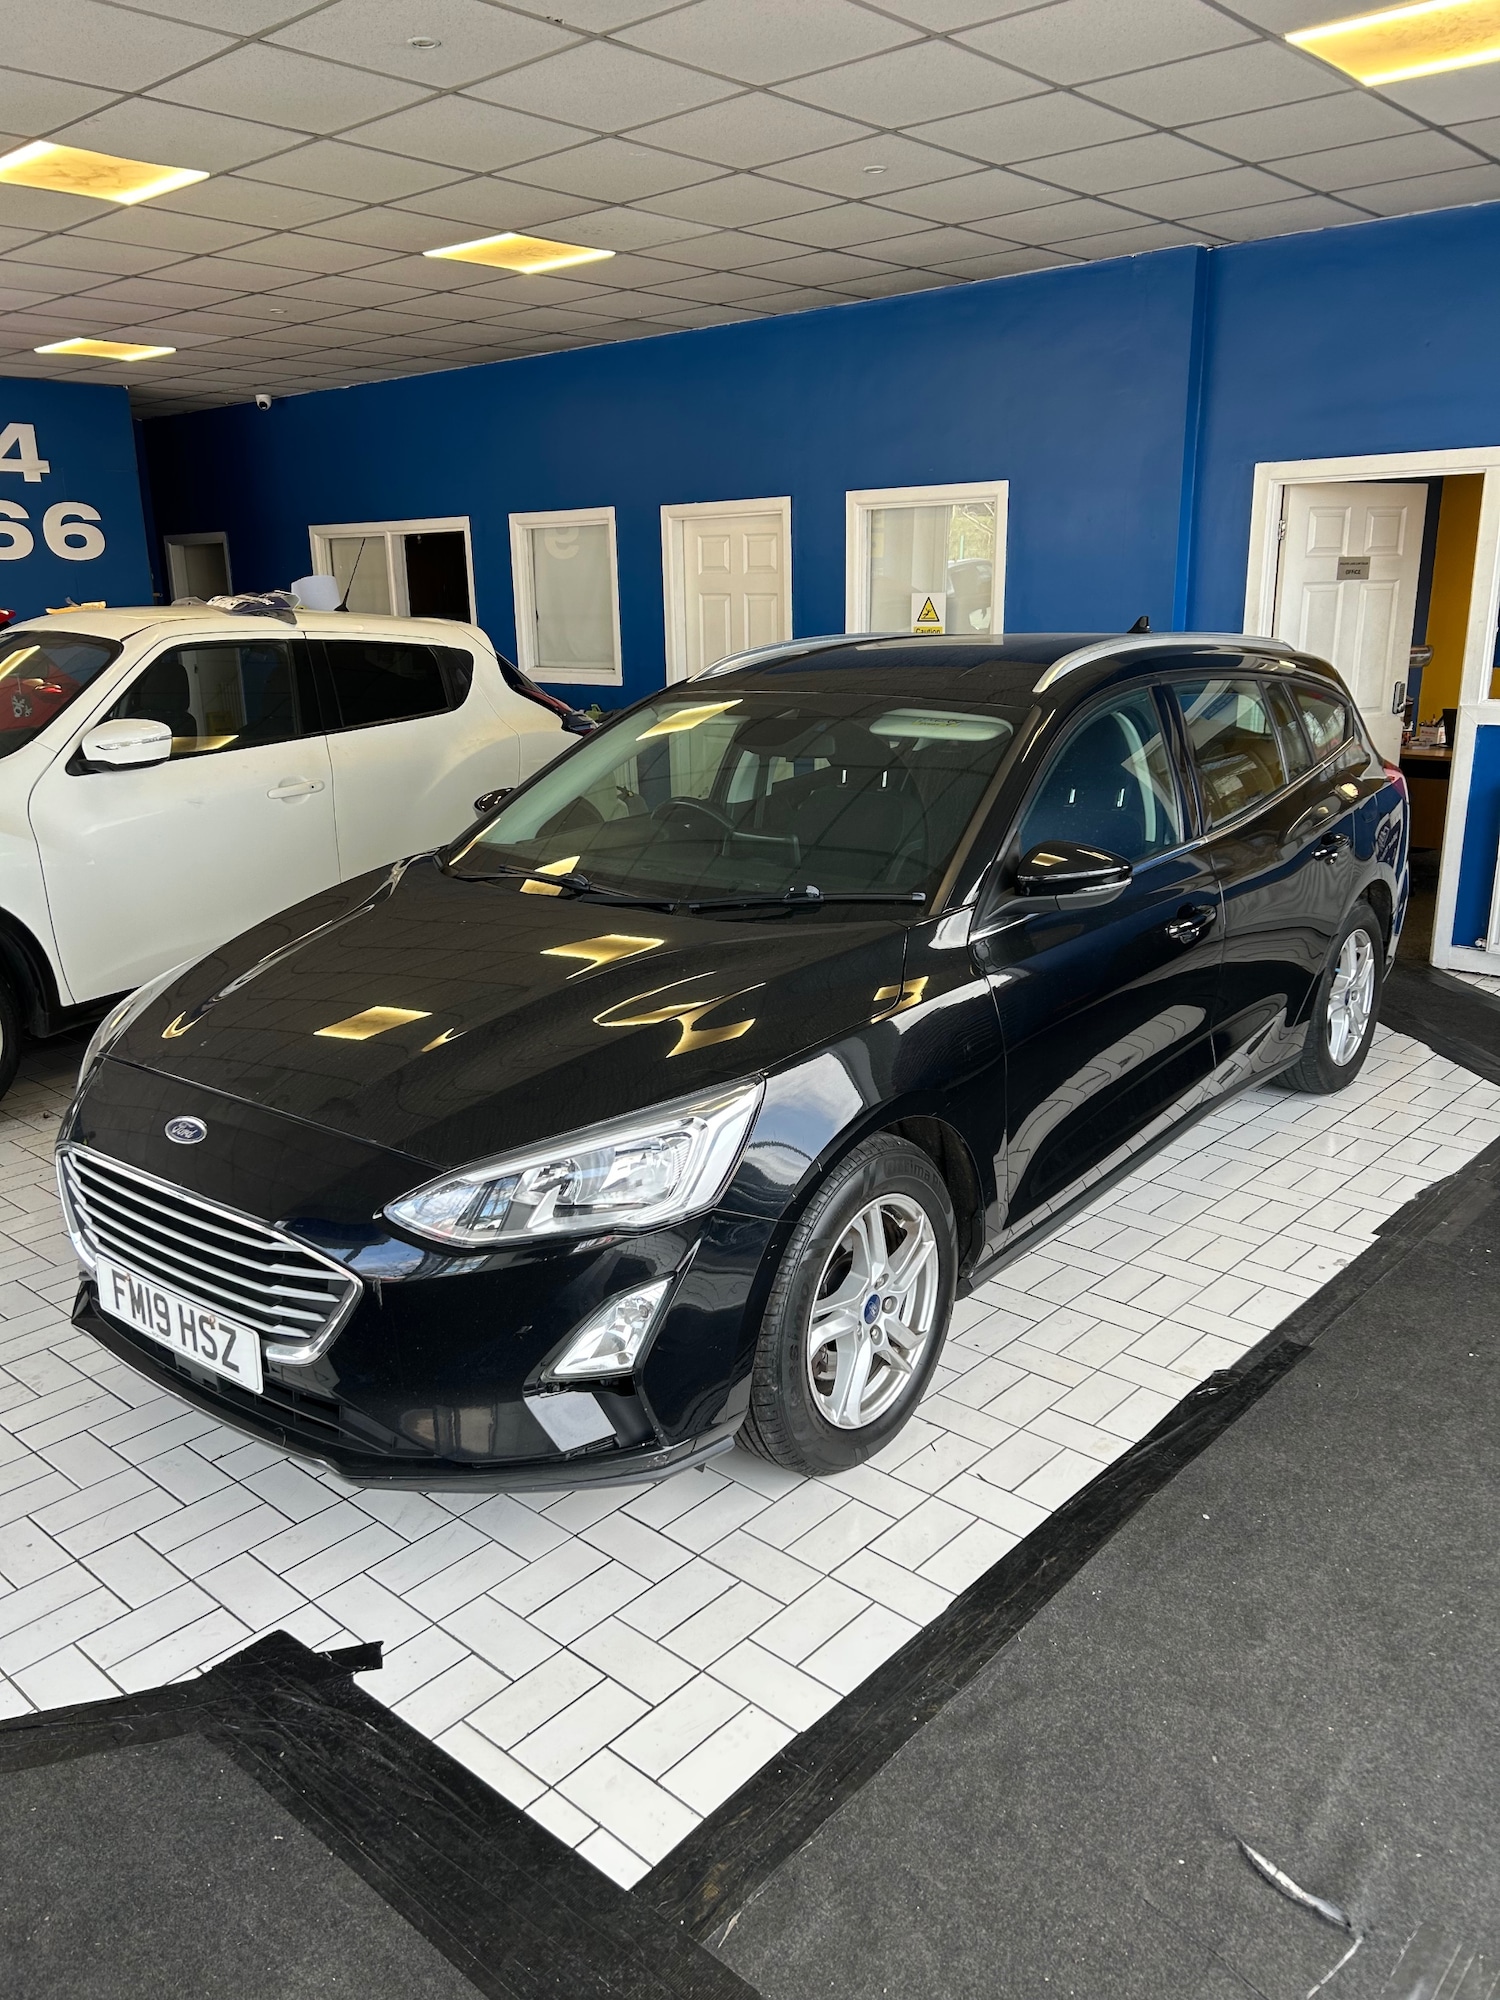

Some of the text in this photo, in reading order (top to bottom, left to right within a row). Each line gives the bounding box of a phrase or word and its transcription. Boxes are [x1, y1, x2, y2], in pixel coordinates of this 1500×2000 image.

[0, 422, 51, 483] 4
[170, 1120, 201, 1140] Ford
[111, 1268, 240, 1374] FM19 HSZ
